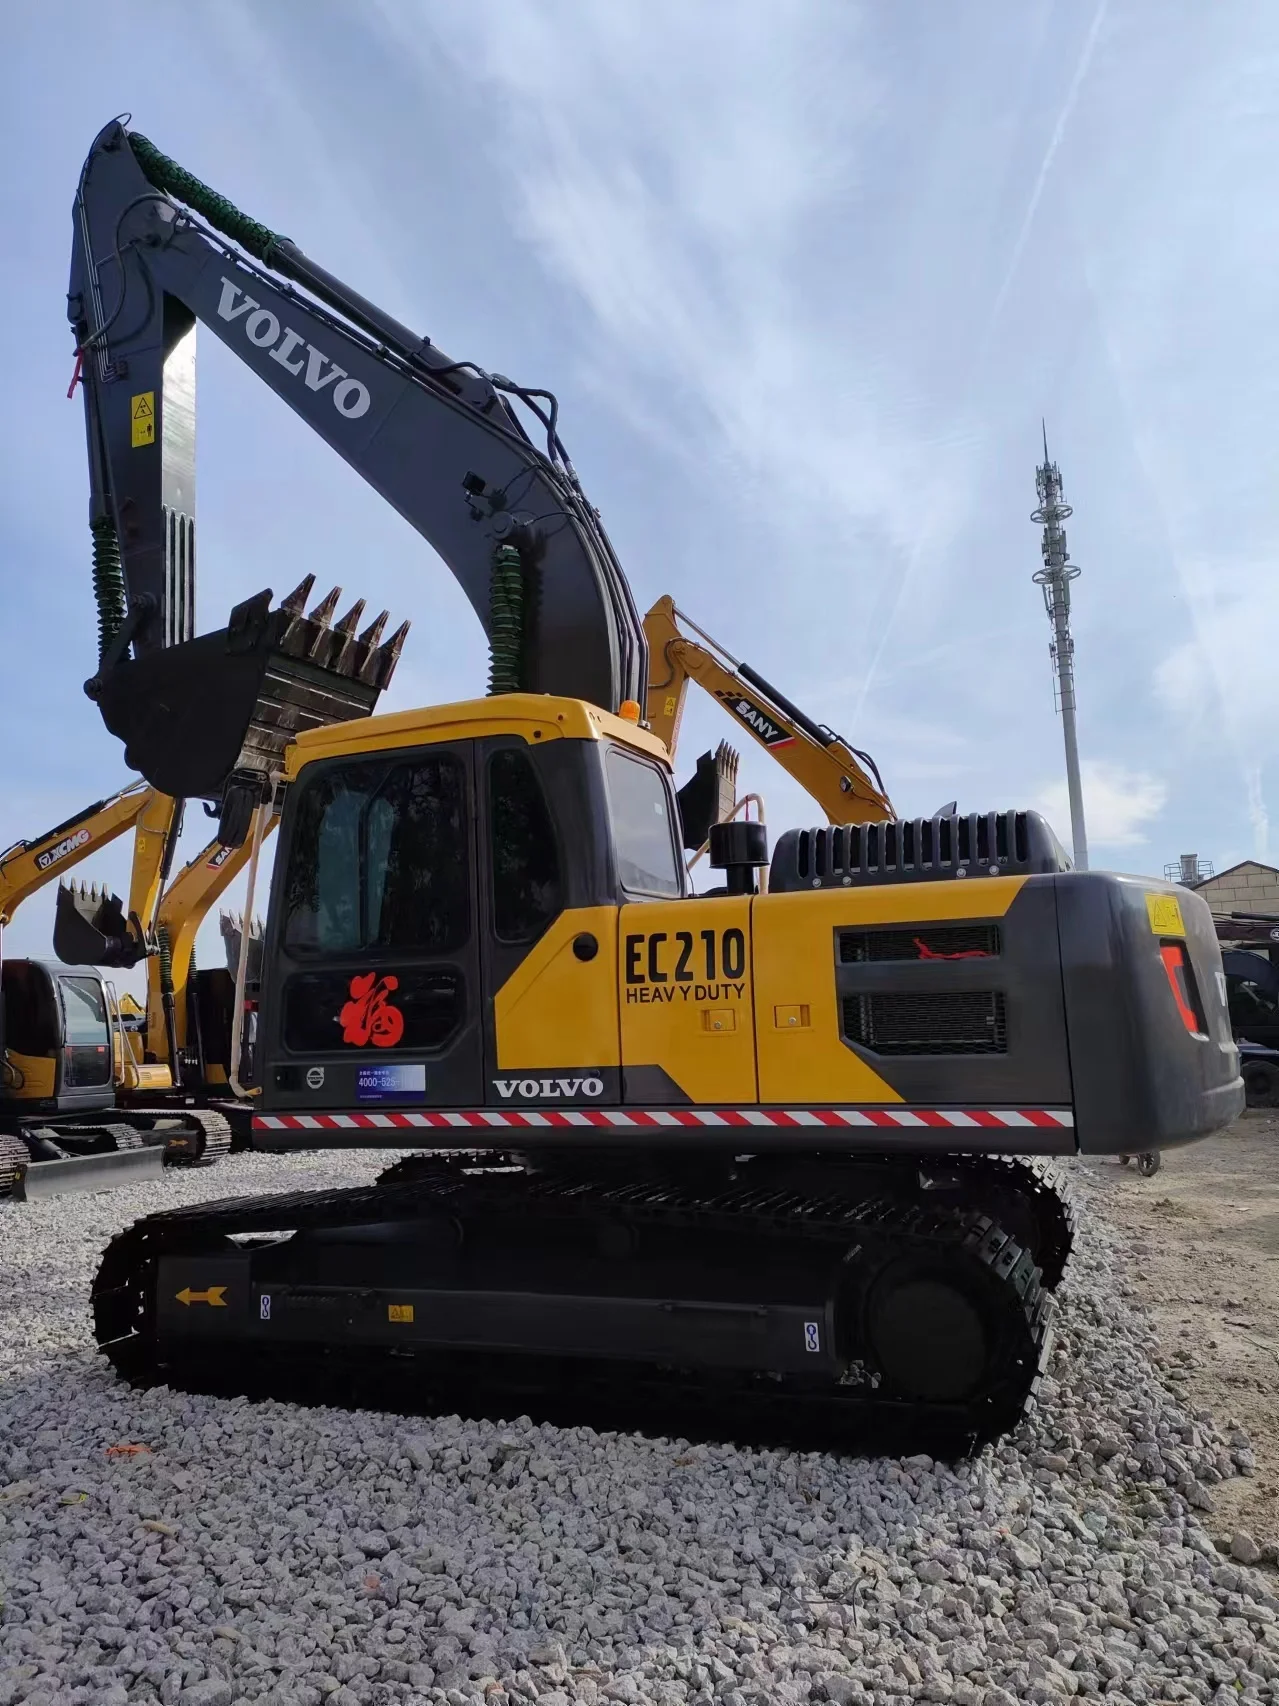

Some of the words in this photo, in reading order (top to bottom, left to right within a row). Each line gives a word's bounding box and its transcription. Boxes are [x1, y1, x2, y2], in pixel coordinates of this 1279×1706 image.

[217, 276, 371, 419] VOLVO
[735, 700, 779, 739] SANY
[50, 829, 90, 862] XCMG
[626, 928, 745, 984] EC210
[340, 971, 404, 1047] 福
[626, 985, 691, 1003] HEAVY
[695, 983, 745, 1001] DUTY
[492, 1078, 604, 1098] VOLVO
